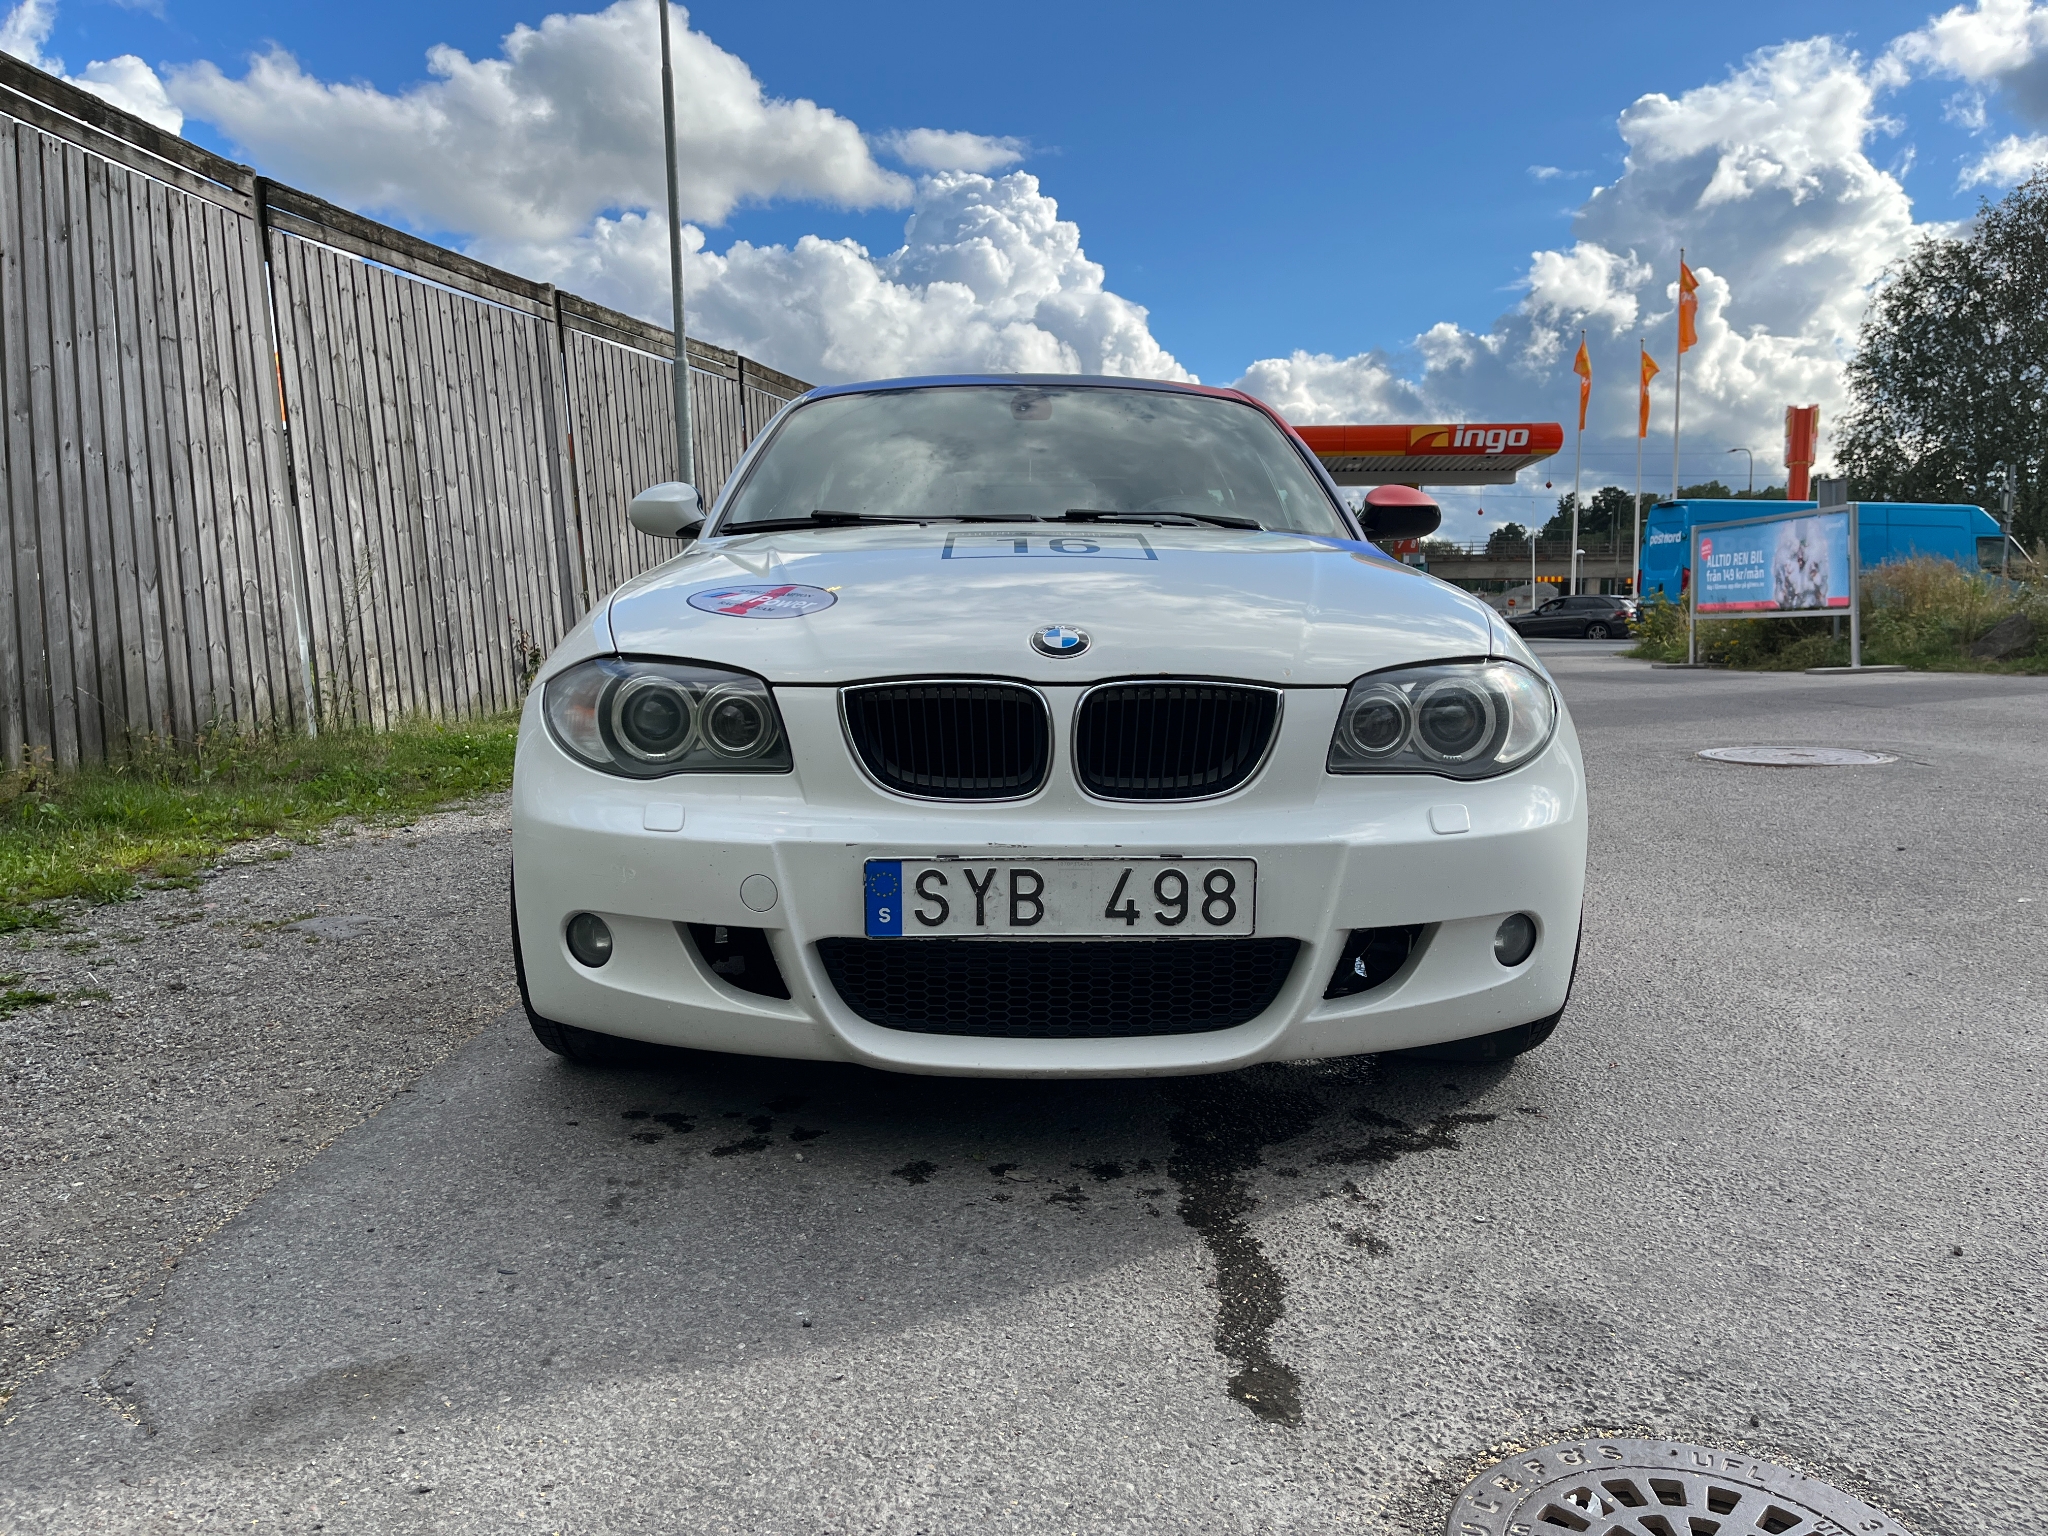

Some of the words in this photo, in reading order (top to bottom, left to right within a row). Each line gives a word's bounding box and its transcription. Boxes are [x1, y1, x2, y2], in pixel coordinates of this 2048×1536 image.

[1453, 425, 1530, 453] ingo
[997, 538, 1101, 554] 16
[1397, 541, 1404, 549] 7
[1649, 531, 1682, 547] postnord
[1706, 552, 1731, 568] ALLTID
[1732, 551, 1749, 567] REN
[1751, 550, 1765, 564] BIL
[1706, 568, 1722, 583] från
[1722, 568, 1735, 581] 149
[1736, 565, 1765, 580] kr/mån
[914, 868, 1045, 927] SYB
[1105, 868, 1237, 926] 498
[878, 907, 891, 924] S
